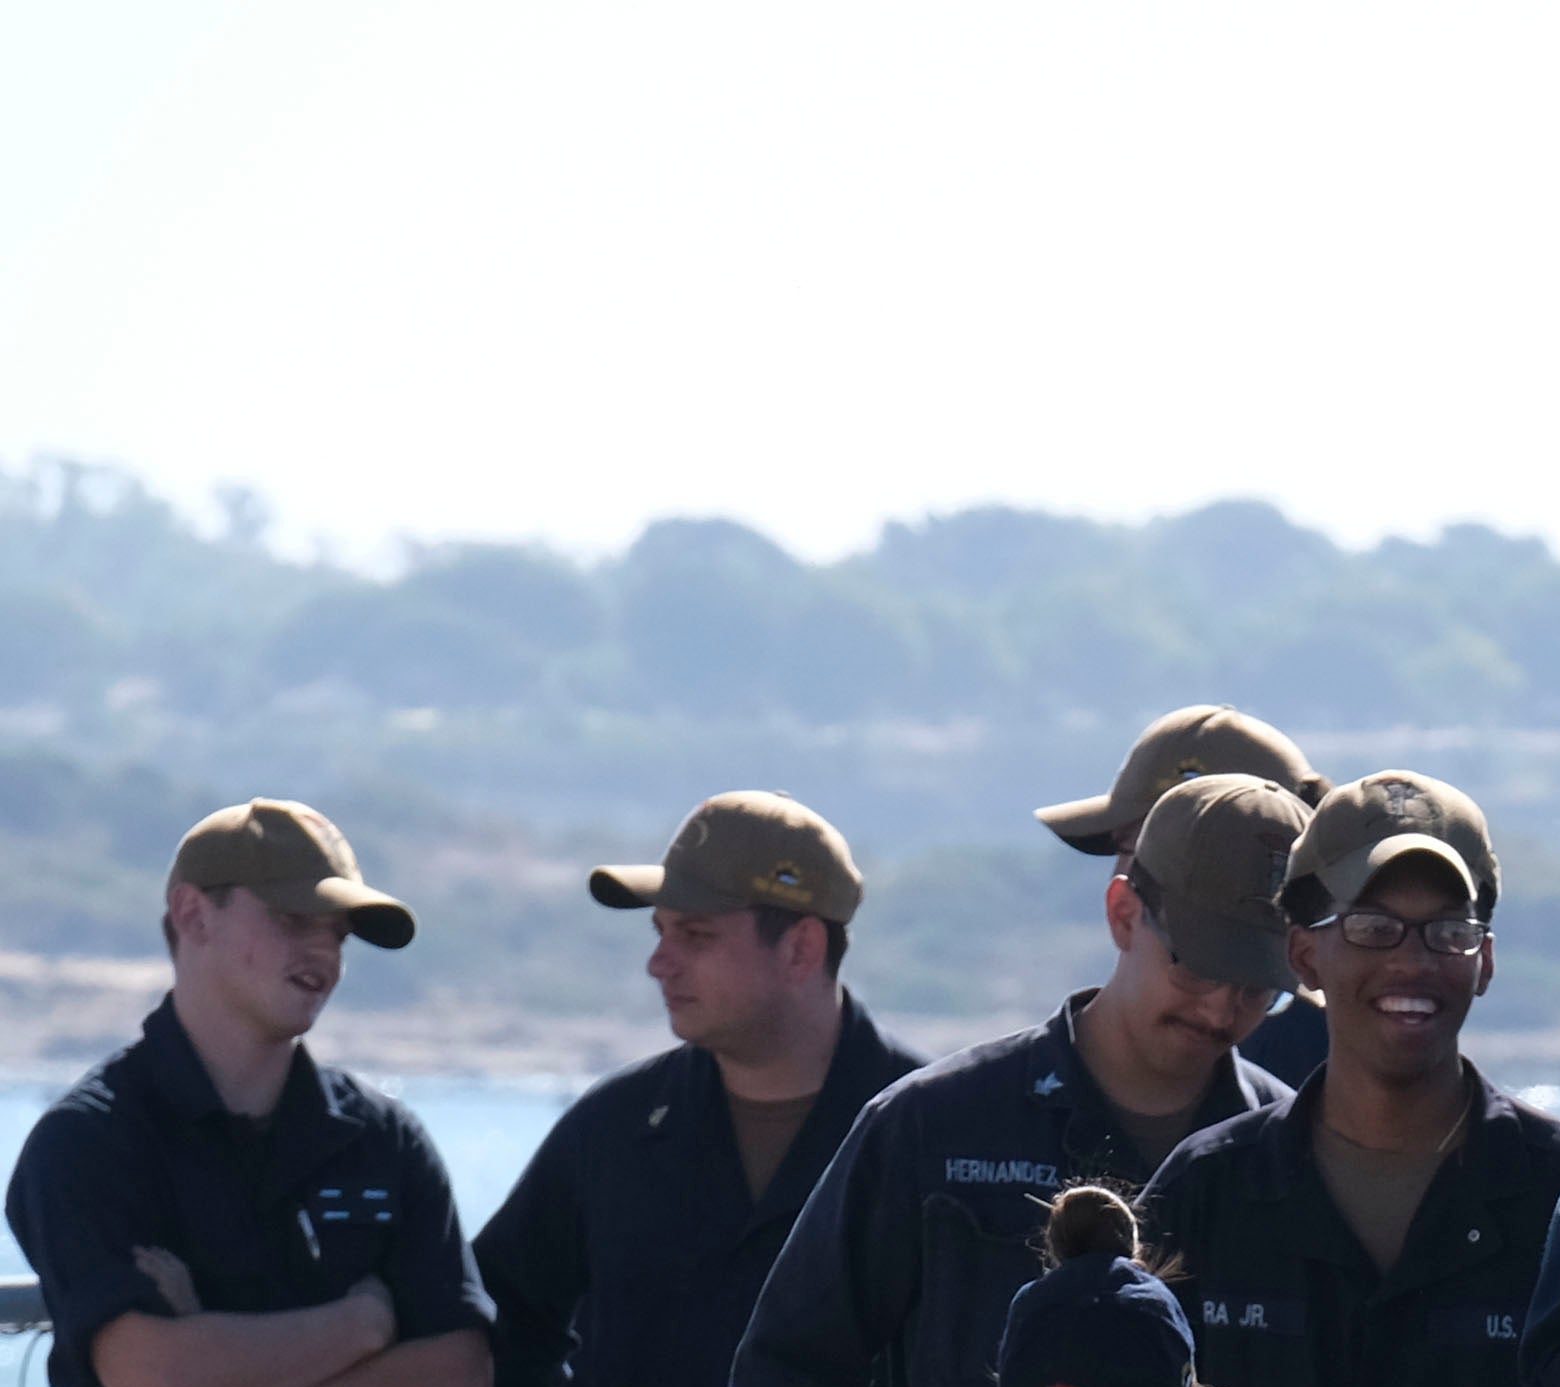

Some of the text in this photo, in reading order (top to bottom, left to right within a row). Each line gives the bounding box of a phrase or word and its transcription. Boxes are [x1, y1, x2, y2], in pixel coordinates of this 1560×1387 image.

[945, 1158, 1059, 1187] HERNANDEZ
[1202, 1299, 1230, 1326] RA
[1486, 1314, 1517, 1339] U.S.
